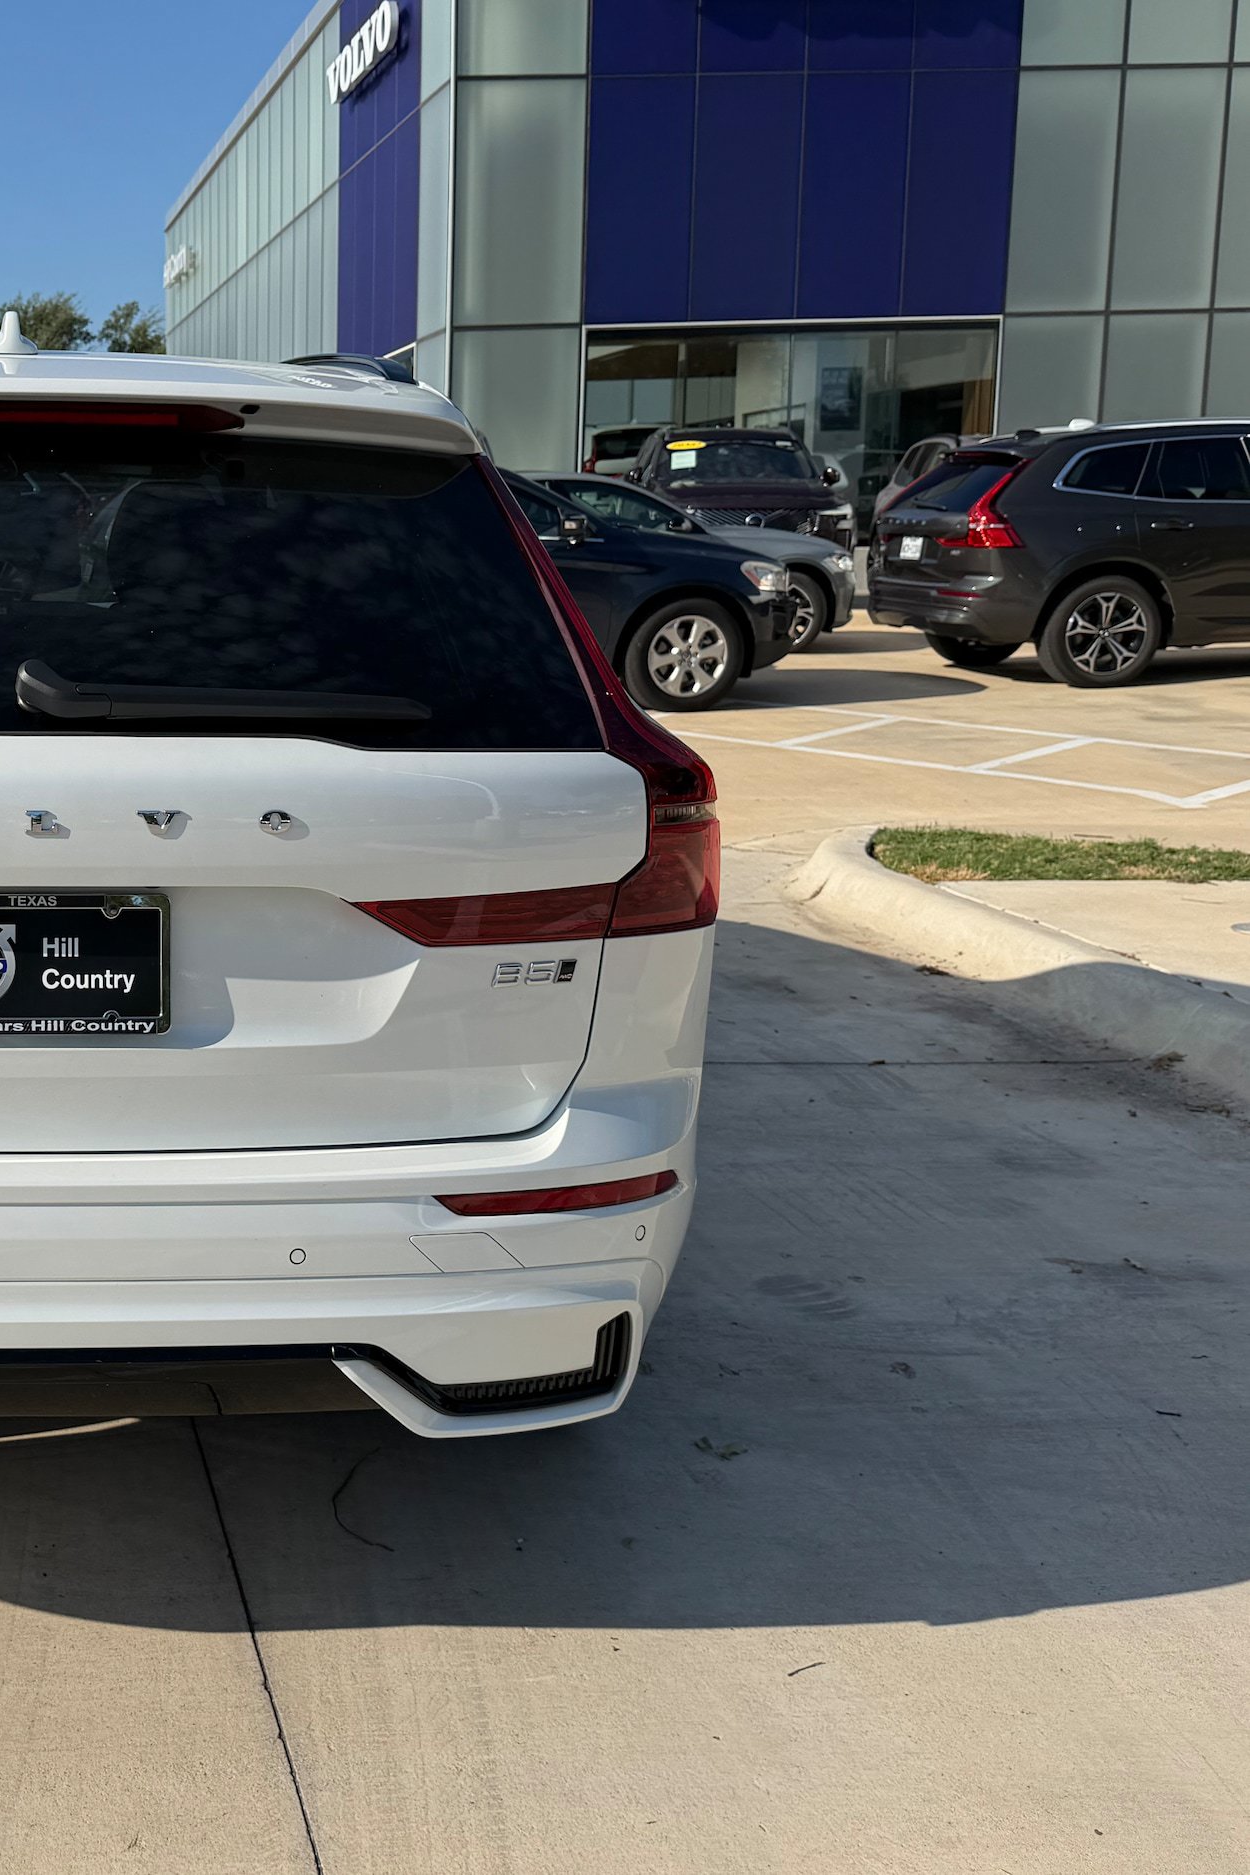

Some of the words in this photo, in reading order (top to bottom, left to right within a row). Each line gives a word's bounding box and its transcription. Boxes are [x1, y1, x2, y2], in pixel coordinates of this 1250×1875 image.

[326, 0, 392, 105] VOLVO
[8, 896, 57, 907] TEXAS
[42, 937, 80, 958] Hill
[42, 968, 136, 994] Country
[31, 1020, 64, 1031] Hill
[71, 1020, 154, 1033] Country
